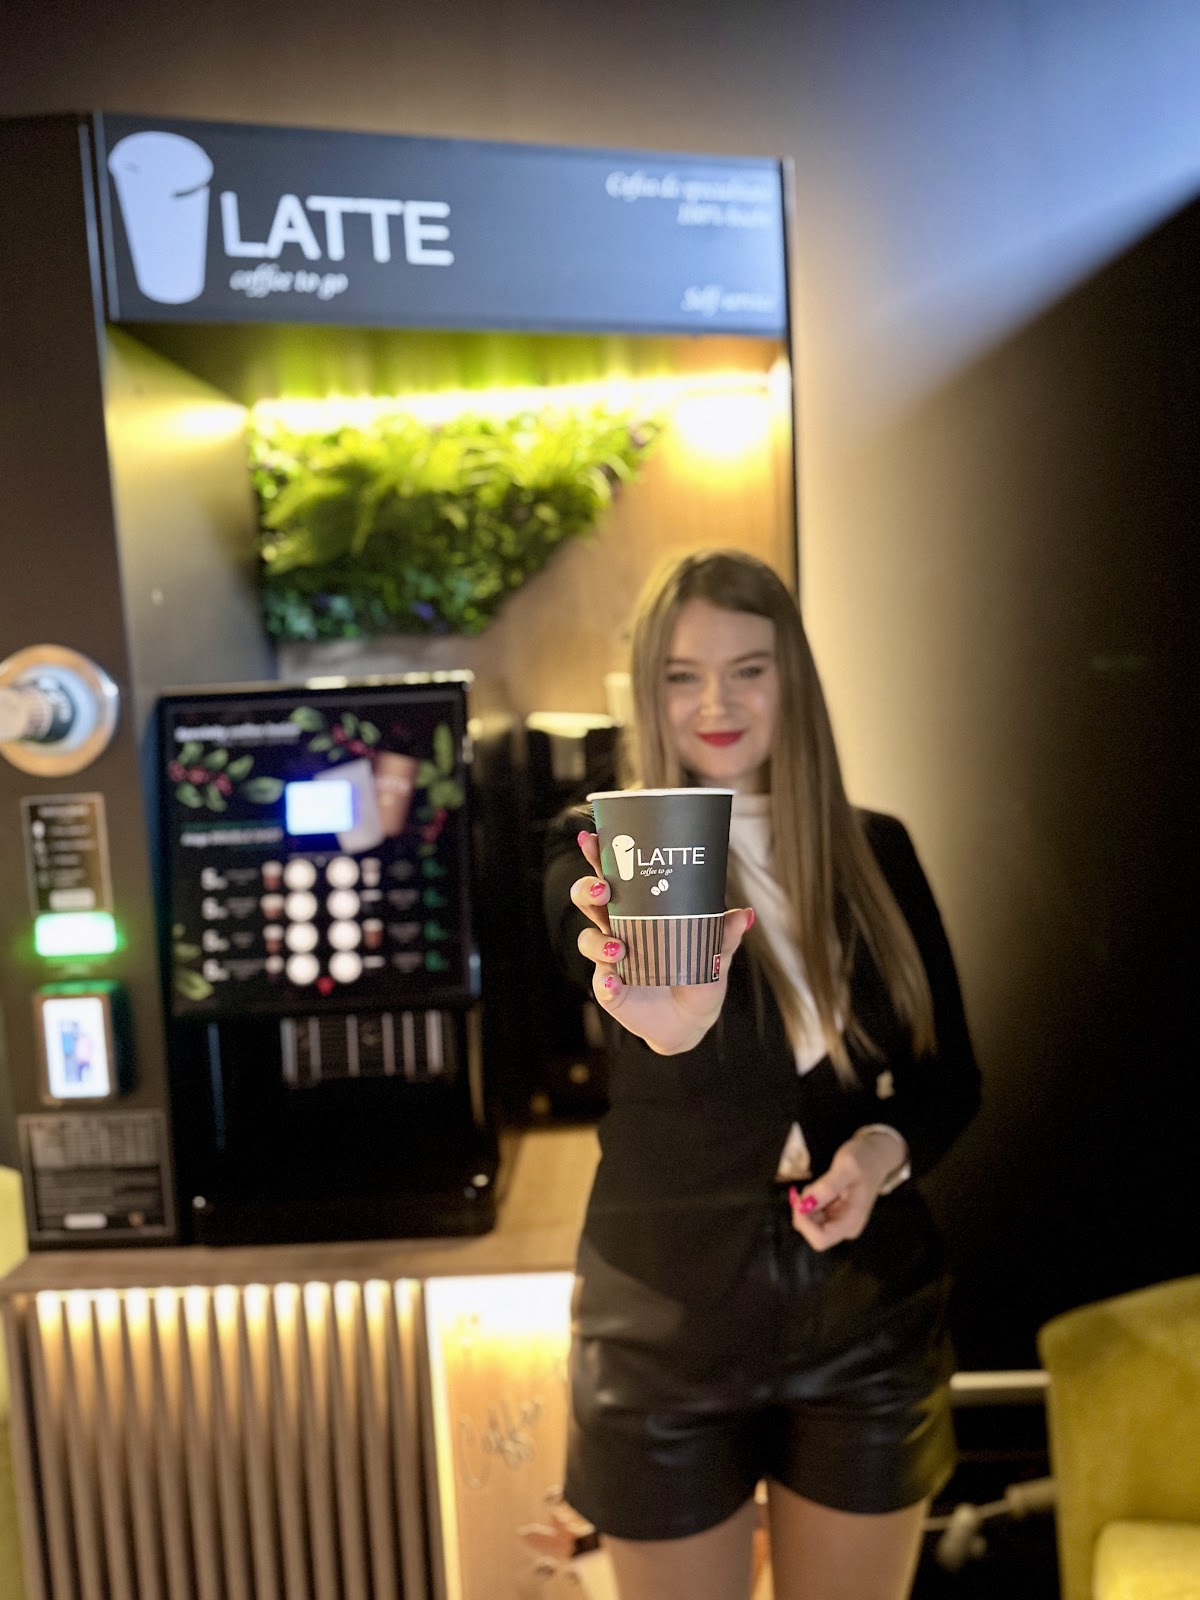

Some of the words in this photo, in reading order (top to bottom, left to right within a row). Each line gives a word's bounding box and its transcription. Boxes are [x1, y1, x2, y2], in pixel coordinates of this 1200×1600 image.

[220, 190, 455, 266] LATTE
[229, 263, 294, 298] coffee
[294, 269, 320, 293] to
[317, 273, 349, 300] go
[637, 847, 705, 866] LATTE
[640, 868, 657, 876] coffee
[665, 868, 673, 876] go
